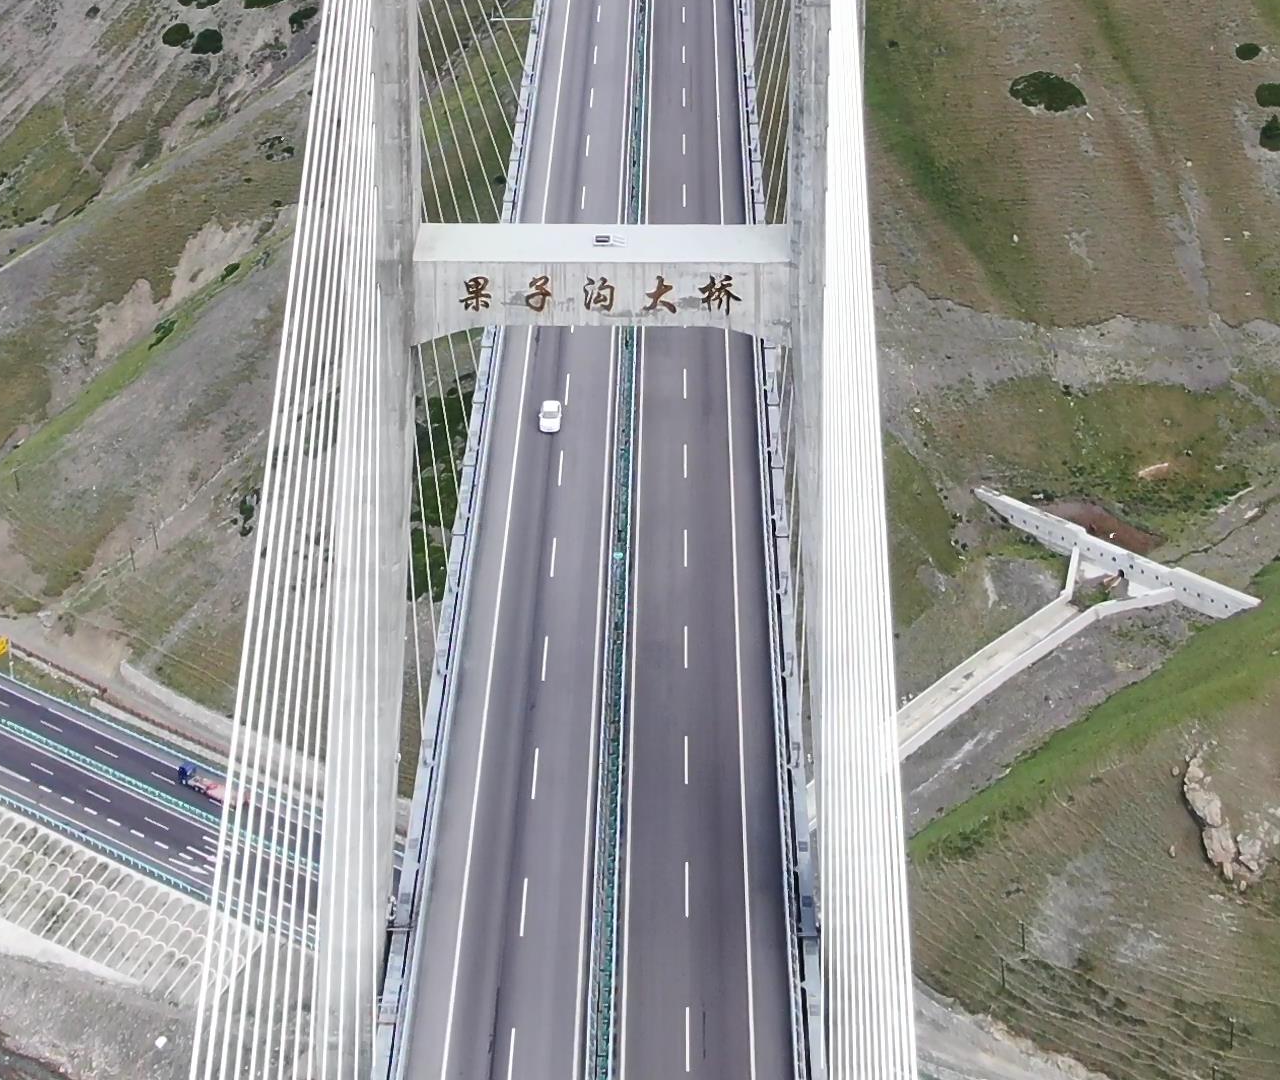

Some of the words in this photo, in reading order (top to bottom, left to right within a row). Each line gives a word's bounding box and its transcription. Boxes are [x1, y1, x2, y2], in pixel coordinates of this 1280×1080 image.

[459, 276, 742, 315] 果子沟大桥
